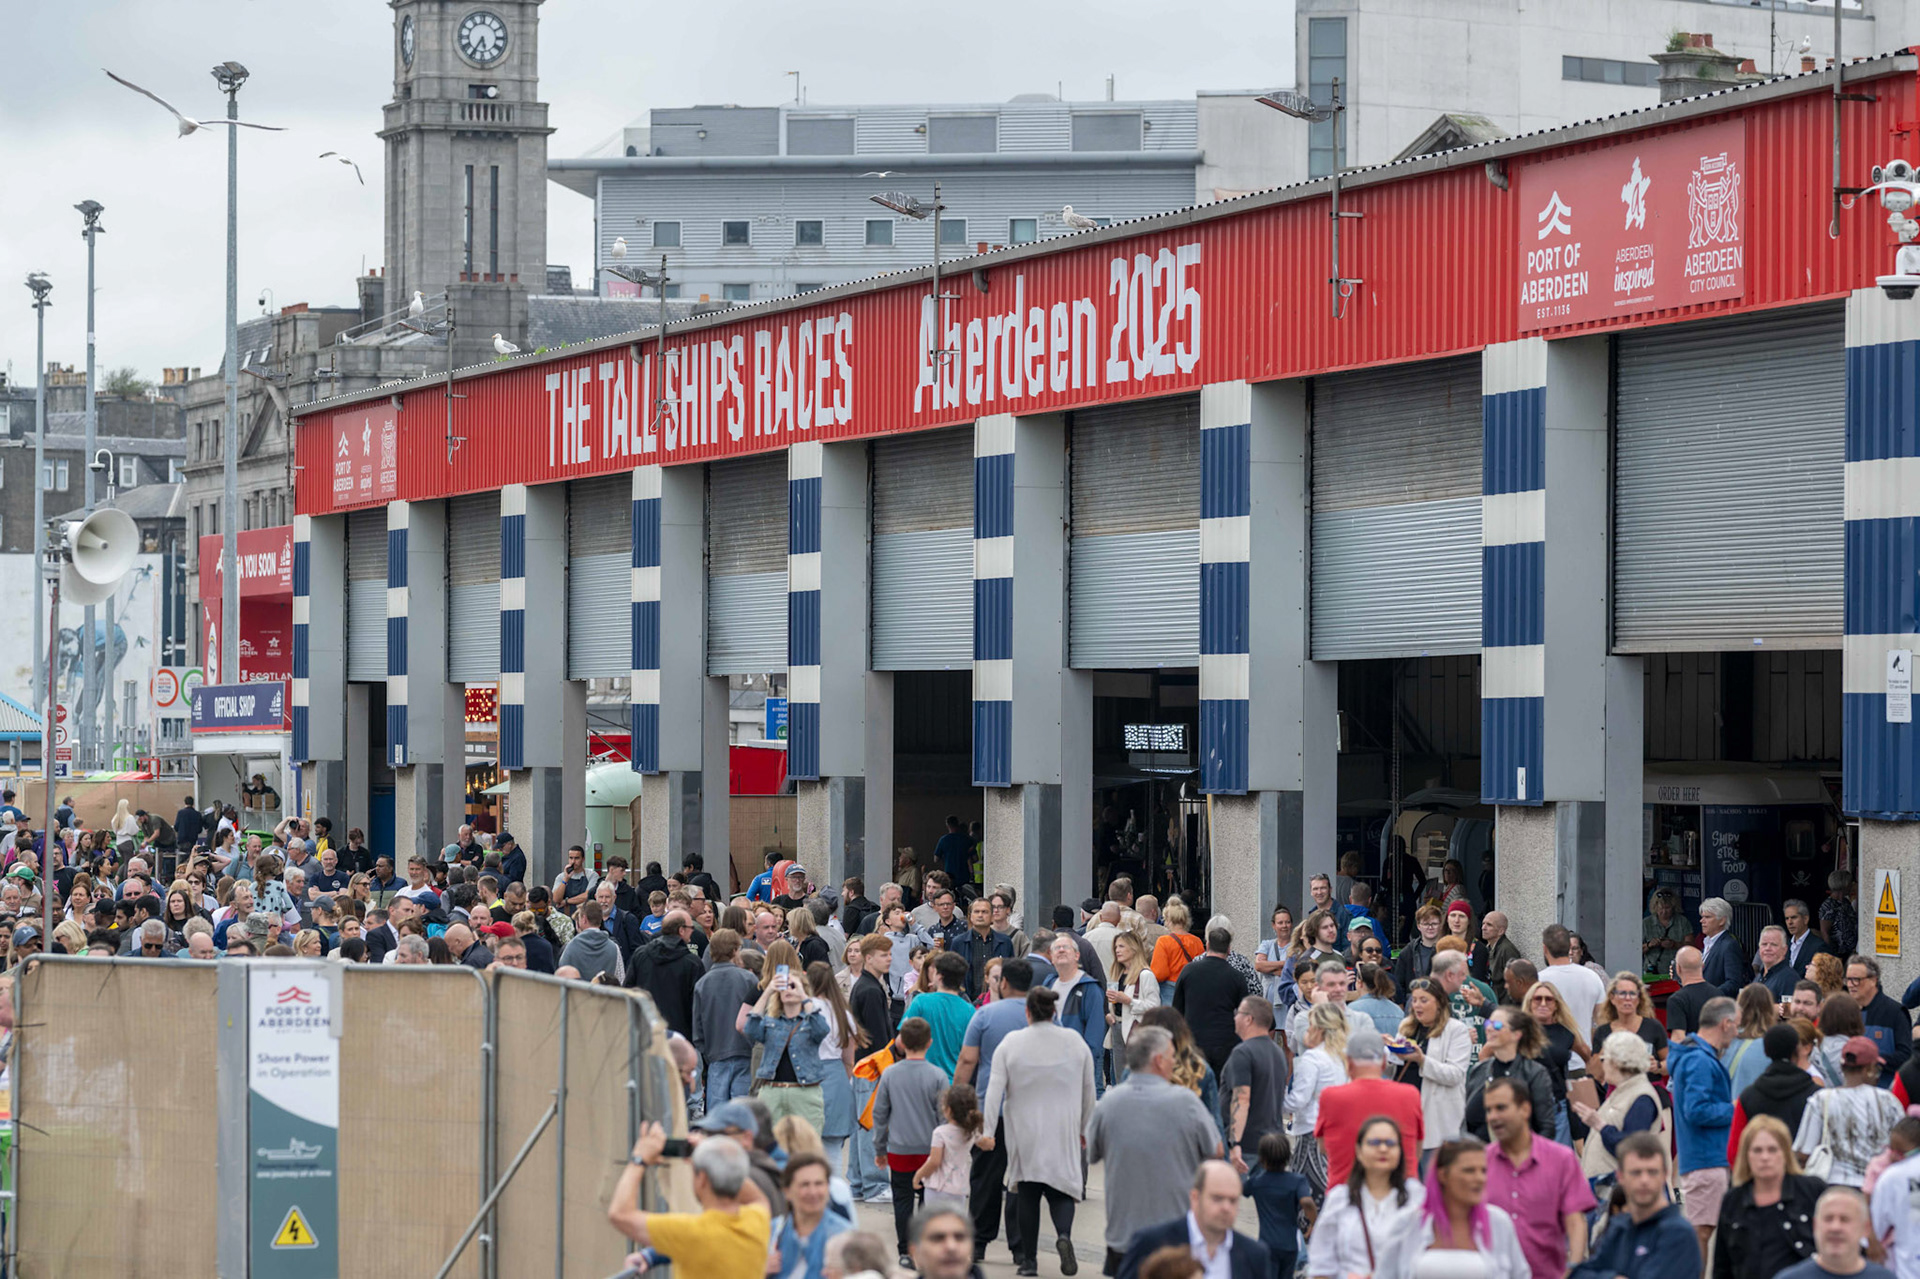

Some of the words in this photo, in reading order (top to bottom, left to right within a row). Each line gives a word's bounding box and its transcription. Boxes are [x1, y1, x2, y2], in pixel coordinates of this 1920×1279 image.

[1528, 246, 1561, 274] PORT
[1564, 242, 1581, 268] OF
[1616, 244, 1653, 263] ABERDEEN
[1684, 246, 1742, 277] ABERDEEN
[1614, 259, 1655, 296] inspired
[1690, 279, 1705, 293] CITY
[1706, 274, 1736, 290] COUNCIL
[1520, 271, 1588, 305] ABERDEEN
[914, 275, 1096, 413] Aberdeen
[1106, 243, 1200, 384] 2025
[546, 367, 590, 467] THE
[599, 354, 656, 459] TALL
[665, 335, 744, 451] SHIPS
[755, 312, 852, 436] RACES
[335, 462, 346, 476] PORT
[334, 476, 354, 492] ABERDEEN
[245, 554, 257, 578] YOU
[258, 552, 276, 578] SOON
[249, 672, 293, 681] SCOTLAN
[214, 696, 238, 718] OFFICIAL
[239, 695, 255, 718] SHOP
[1658, 786, 1680, 801] ORDER
[1683, 787, 1701, 802] HERE
[1712, 830, 1740, 846] SHIPY
[1717, 846, 1740, 861] STRE
[1722, 860, 1746, 873] FOOD
[1876, 920, 1899, 935] Warning
[265, 1006, 301, 1016] PORT
[305, 1006, 321, 1016] OF
[258, 1018, 330, 1028] ABERDEEN
[257, 1052, 291, 1063] Shore
[294, 1052, 329, 1063] Power
[257, 1067, 268, 1078] in
[270, 1067, 331, 1080] Operation
